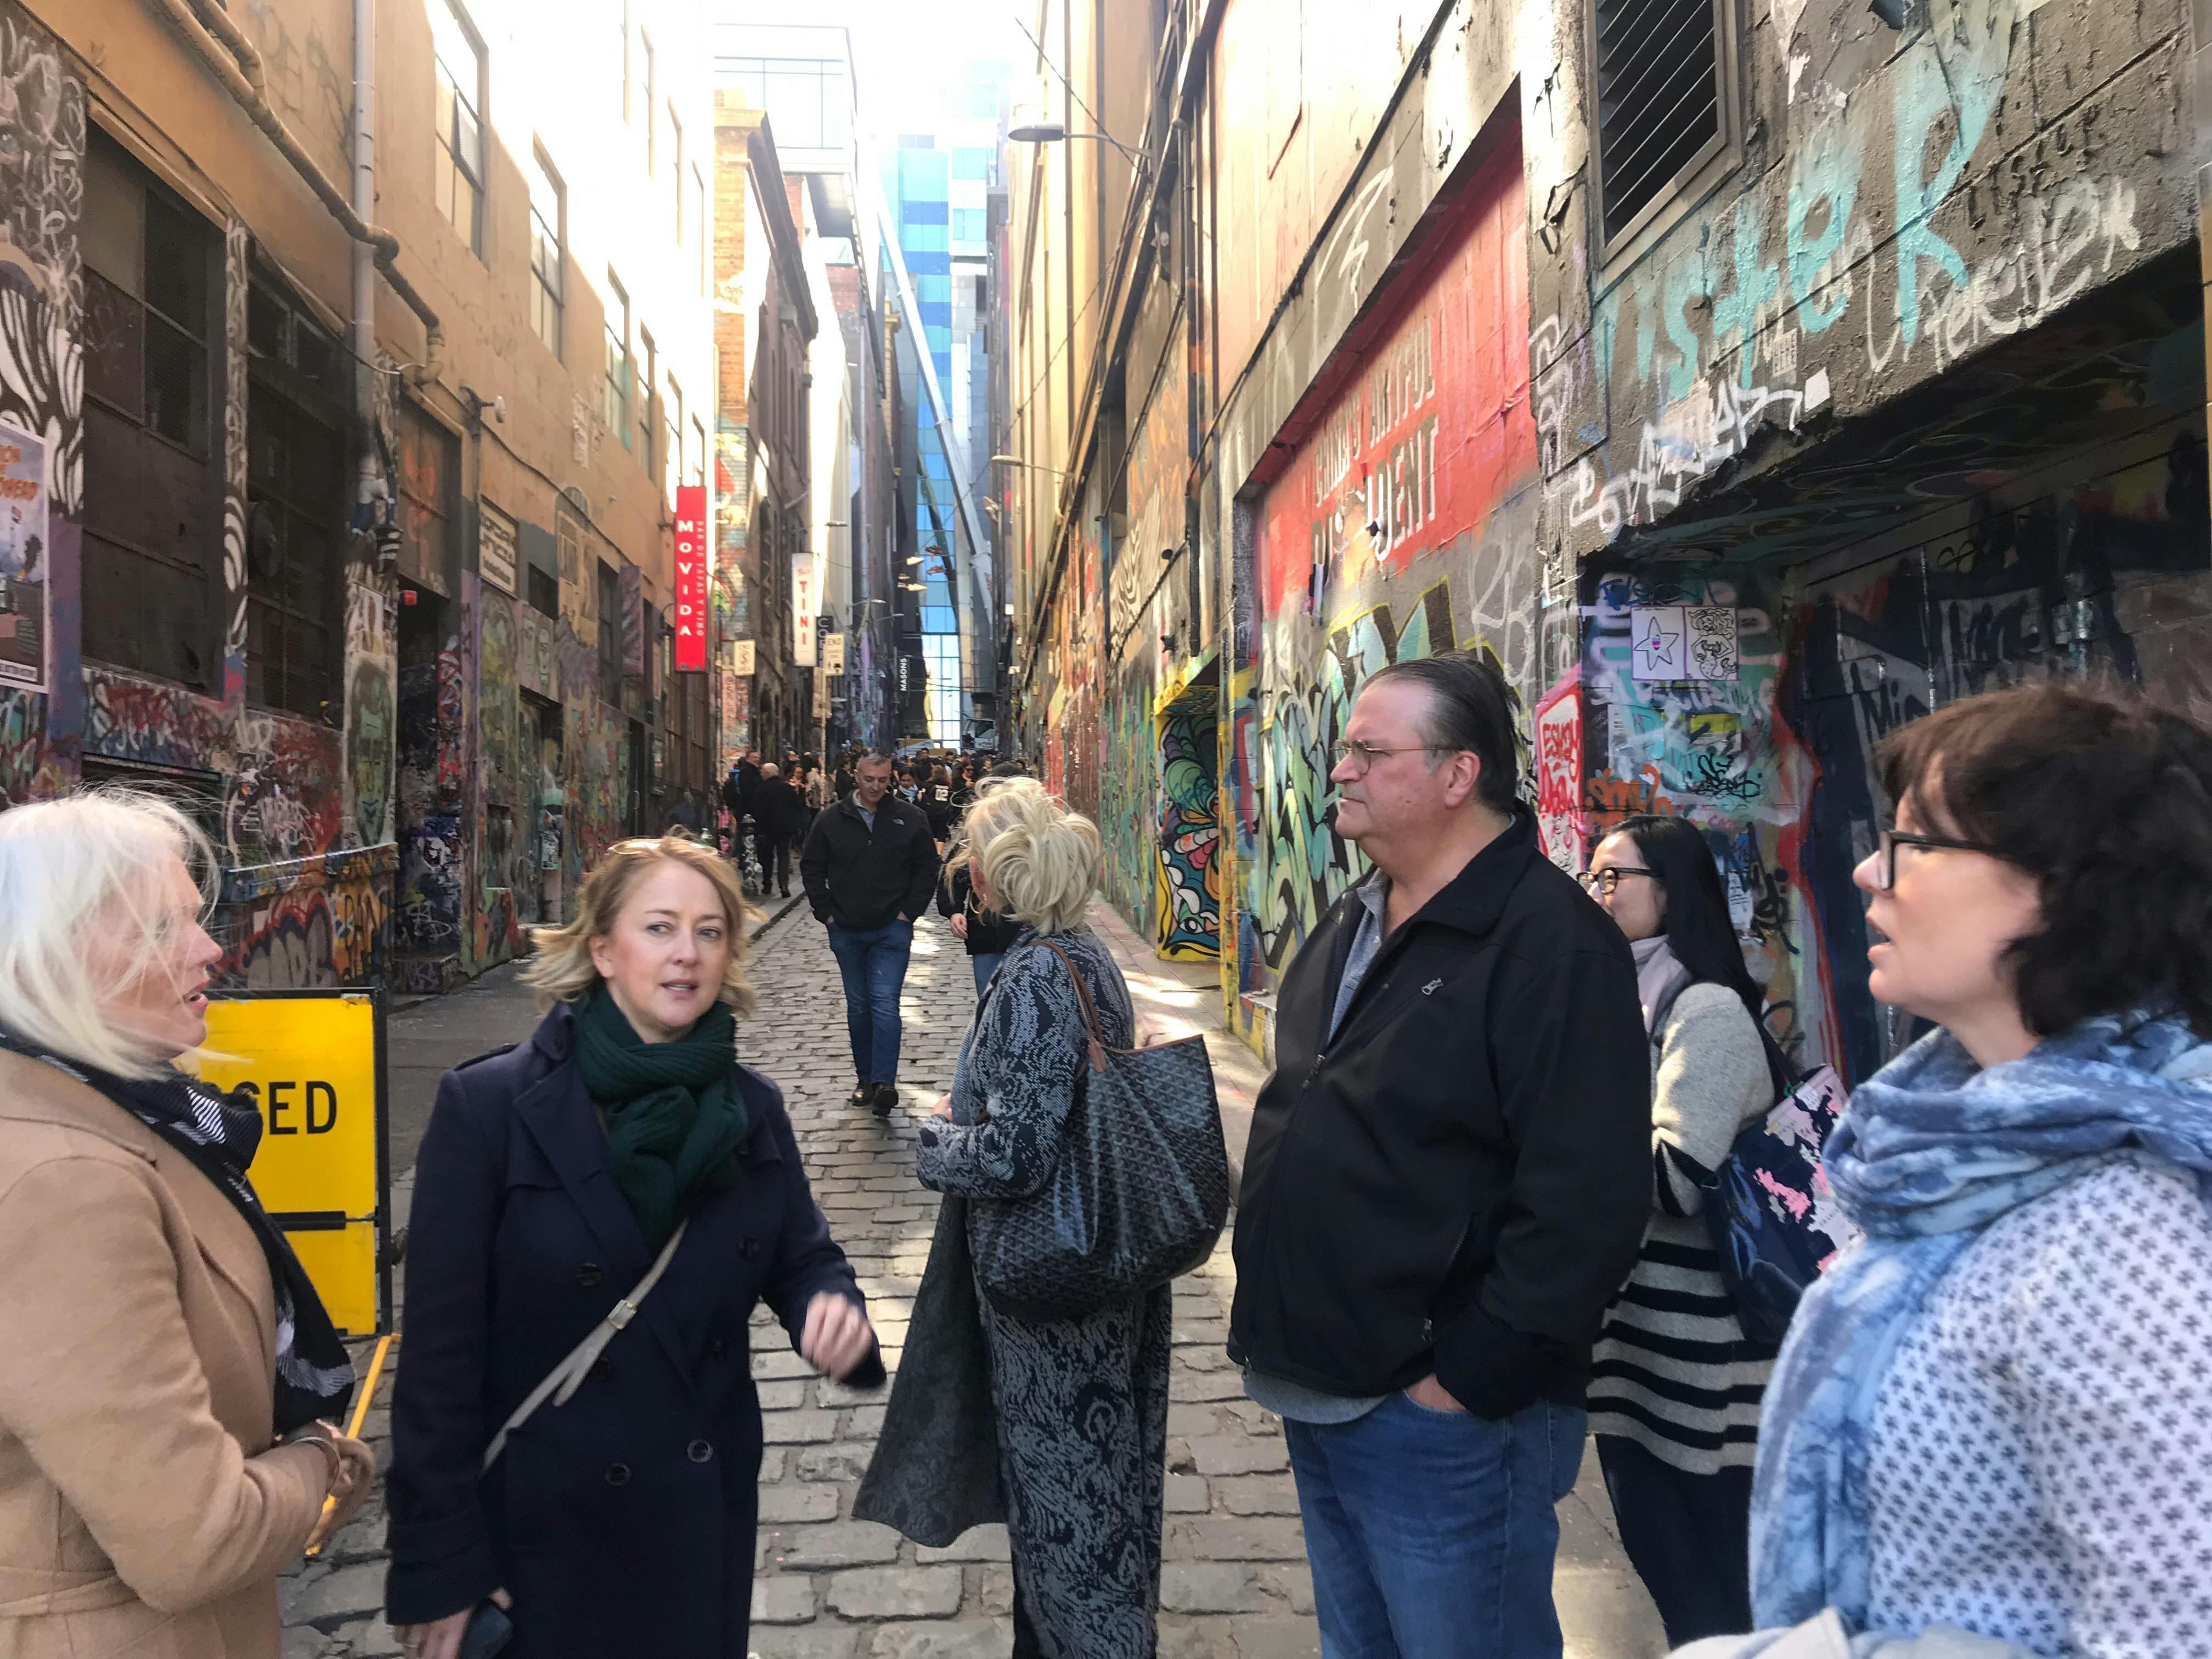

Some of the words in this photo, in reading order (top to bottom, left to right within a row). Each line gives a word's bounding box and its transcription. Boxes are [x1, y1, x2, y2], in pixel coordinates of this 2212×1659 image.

[678, 520, 693, 636] MOVIDA
[799, 581, 809, 645] TINI
[233, 1081, 337, 1135] ED
